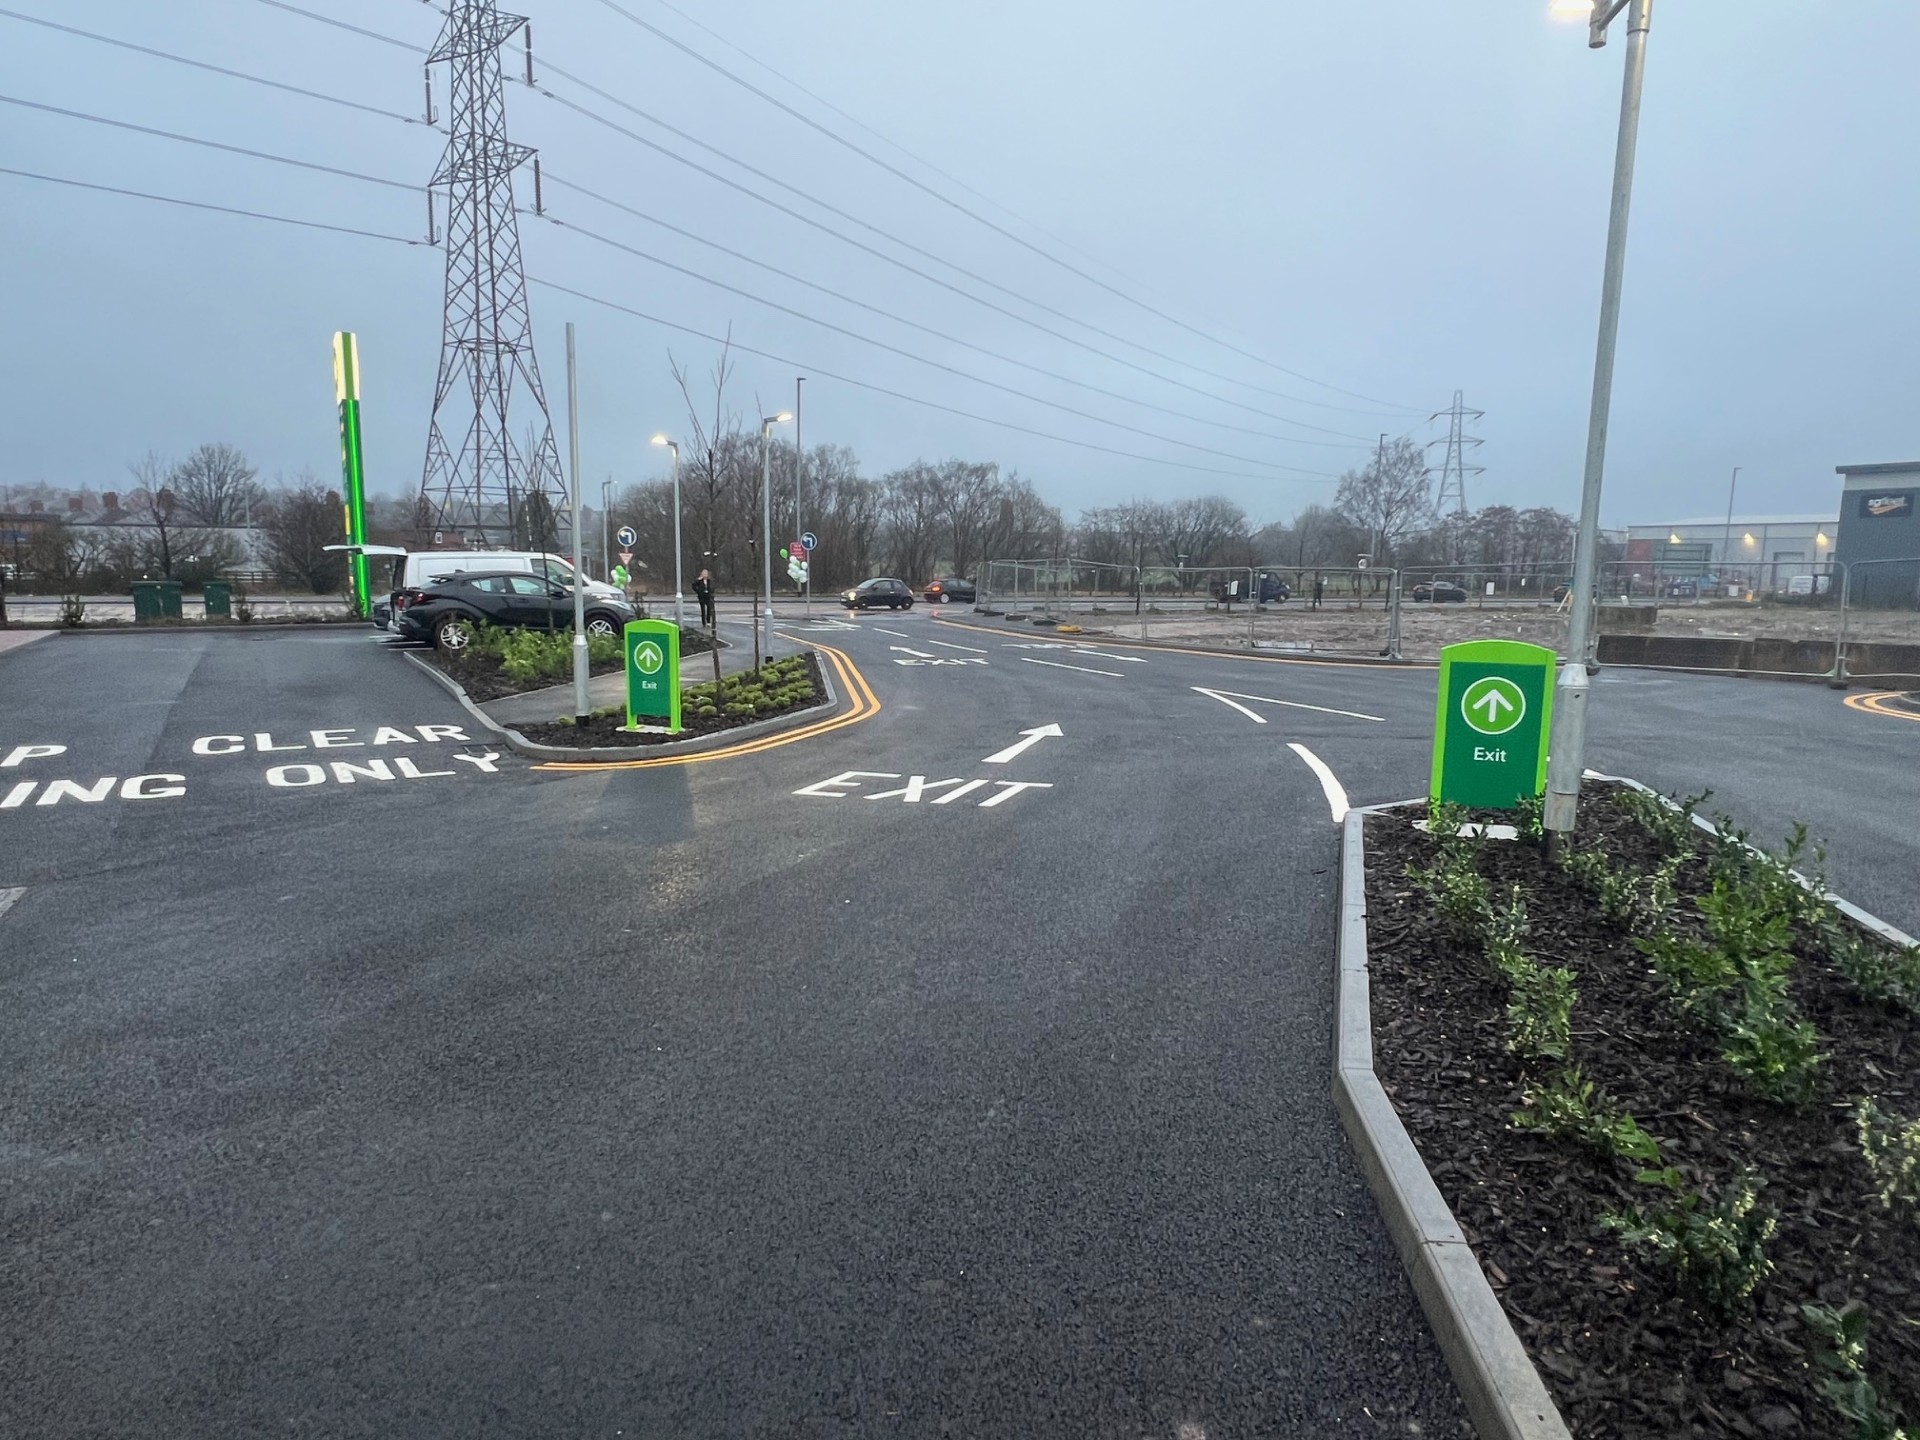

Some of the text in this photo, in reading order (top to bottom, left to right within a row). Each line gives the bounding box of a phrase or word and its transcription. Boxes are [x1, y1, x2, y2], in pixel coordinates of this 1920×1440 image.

[893, 658, 989, 666] EXIT
[642, 680, 657, 689] Exit
[191, 724, 472, 755] CLEAR
[1473, 747, 1507, 762] Exit
[266, 752, 500, 787] ONLY
[792, 770, 1054, 807] EXIT
